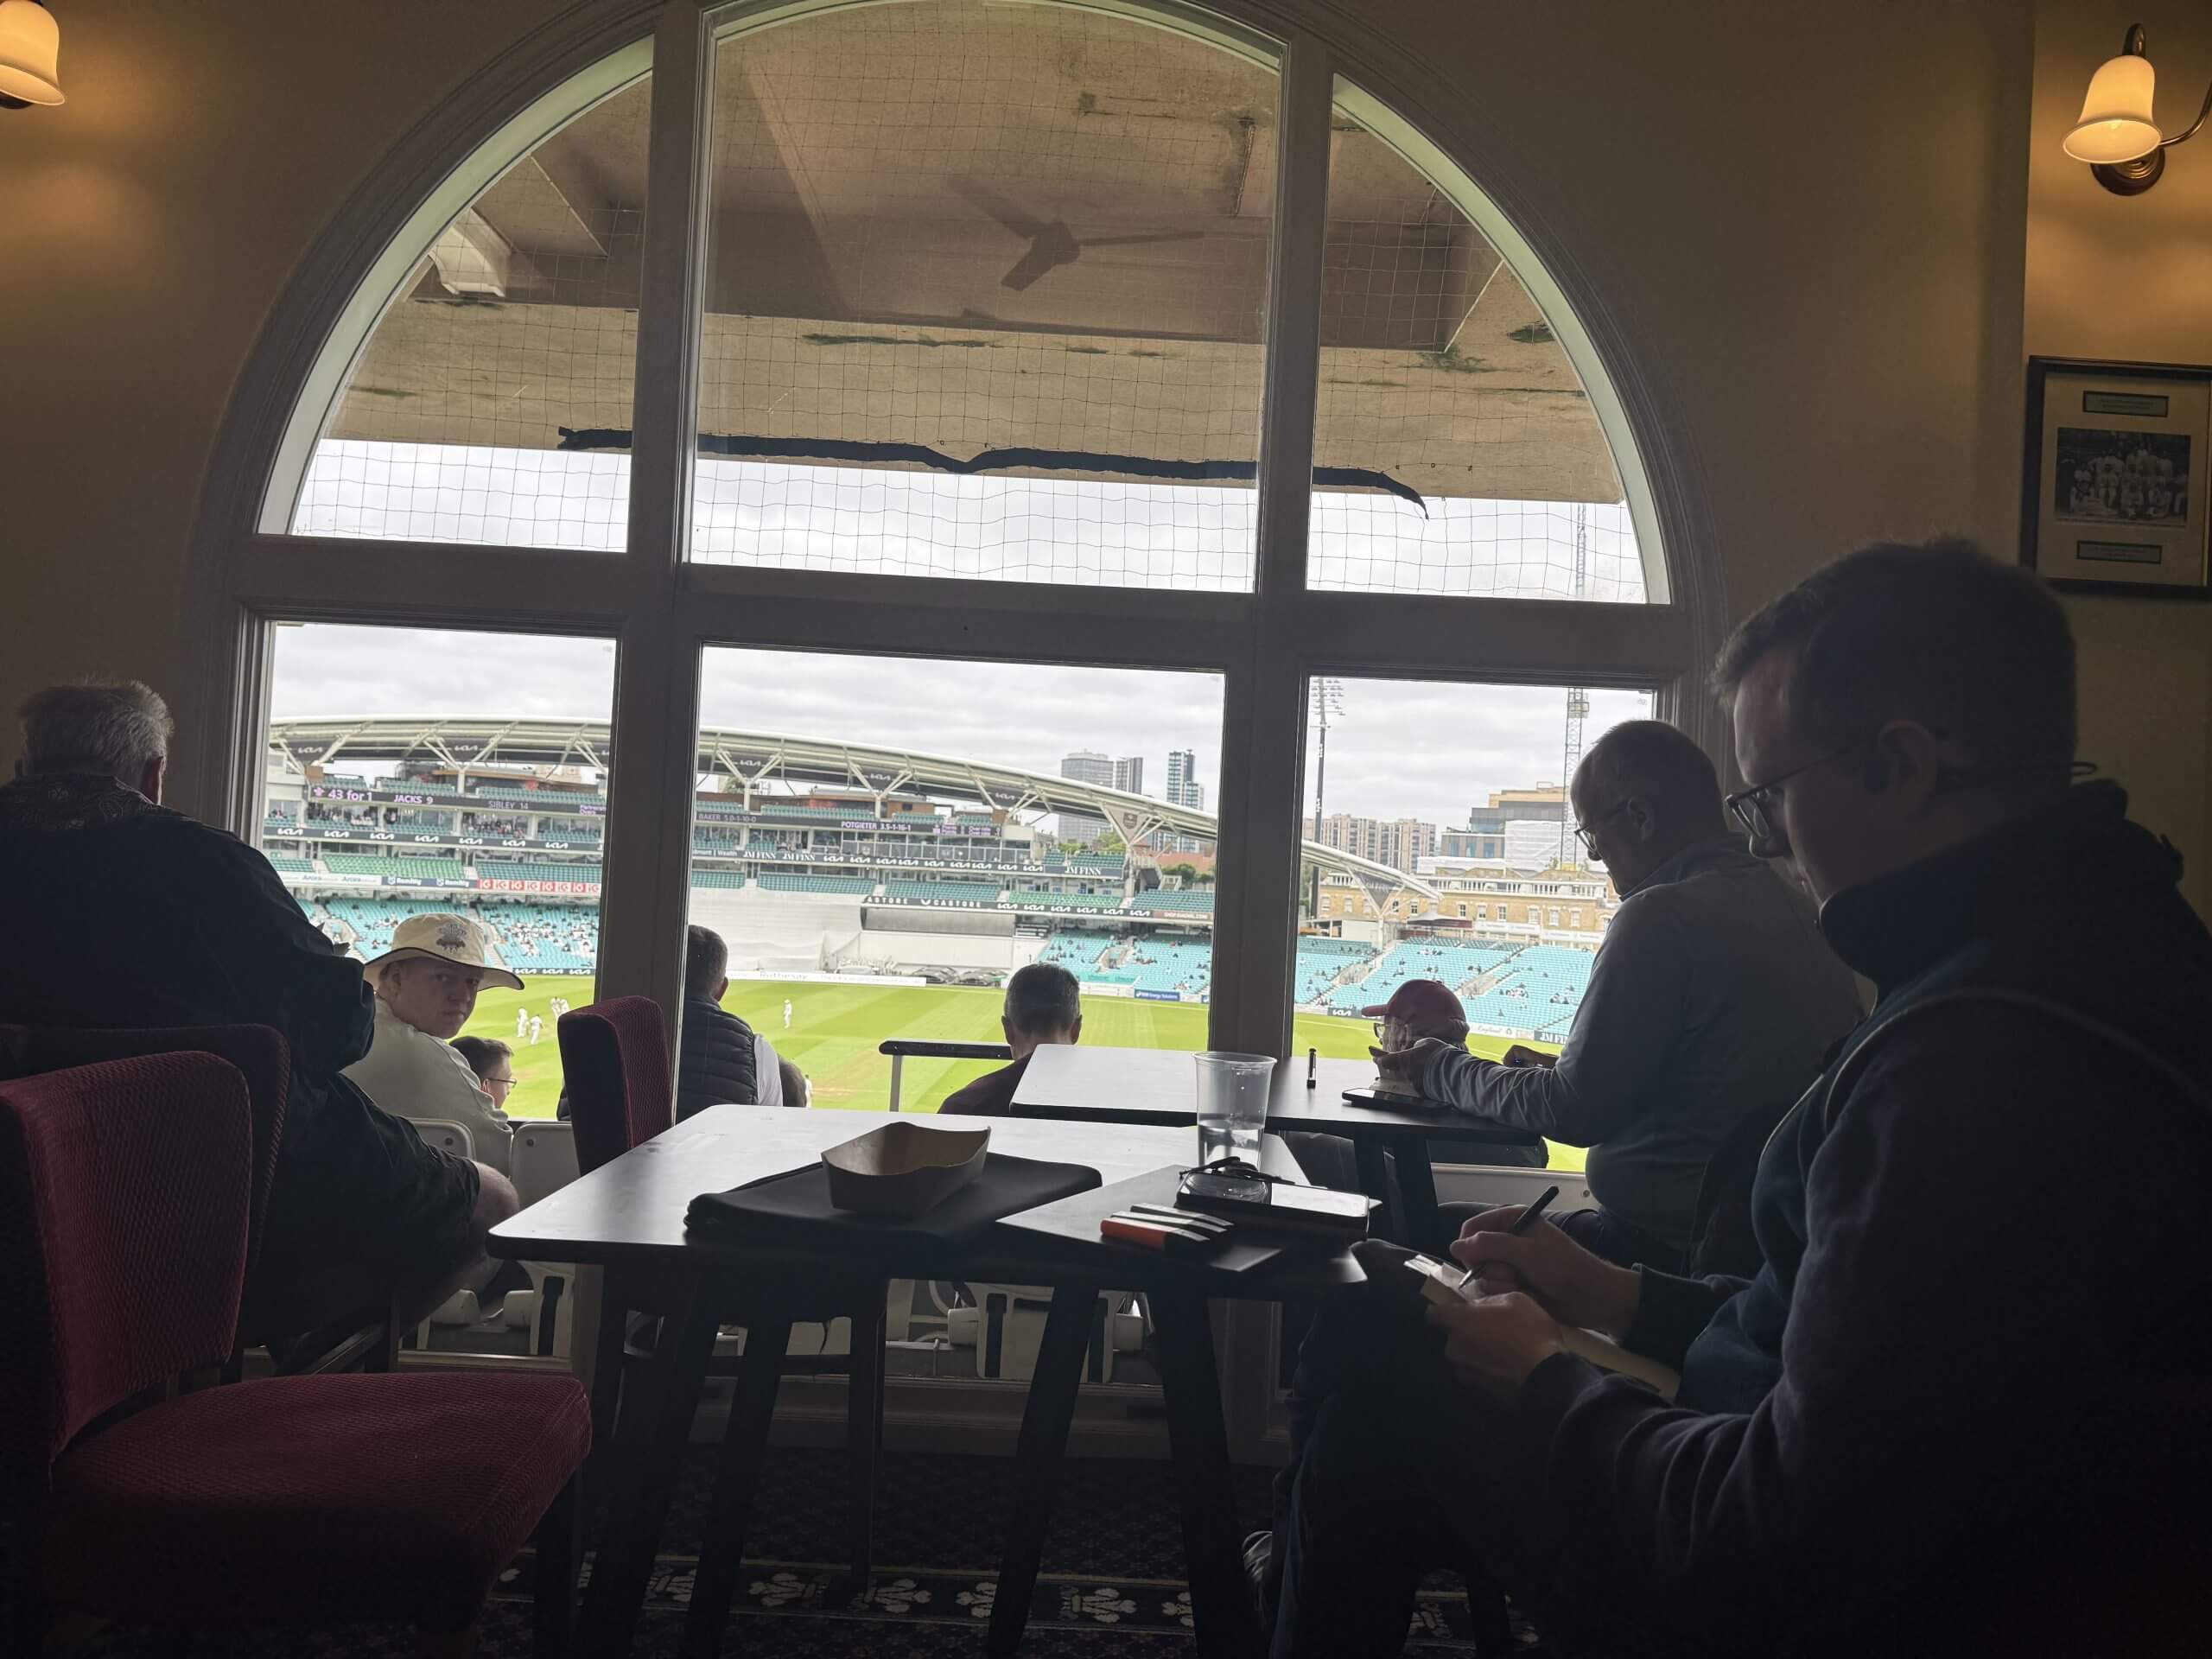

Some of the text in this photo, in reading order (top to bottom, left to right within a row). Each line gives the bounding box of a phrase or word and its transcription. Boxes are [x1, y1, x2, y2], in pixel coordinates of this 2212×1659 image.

[328, 789, 372, 801] 43 for 1
[393, 794, 422, 804] JACKS
[933, 899, 982, 908] CASTORE
